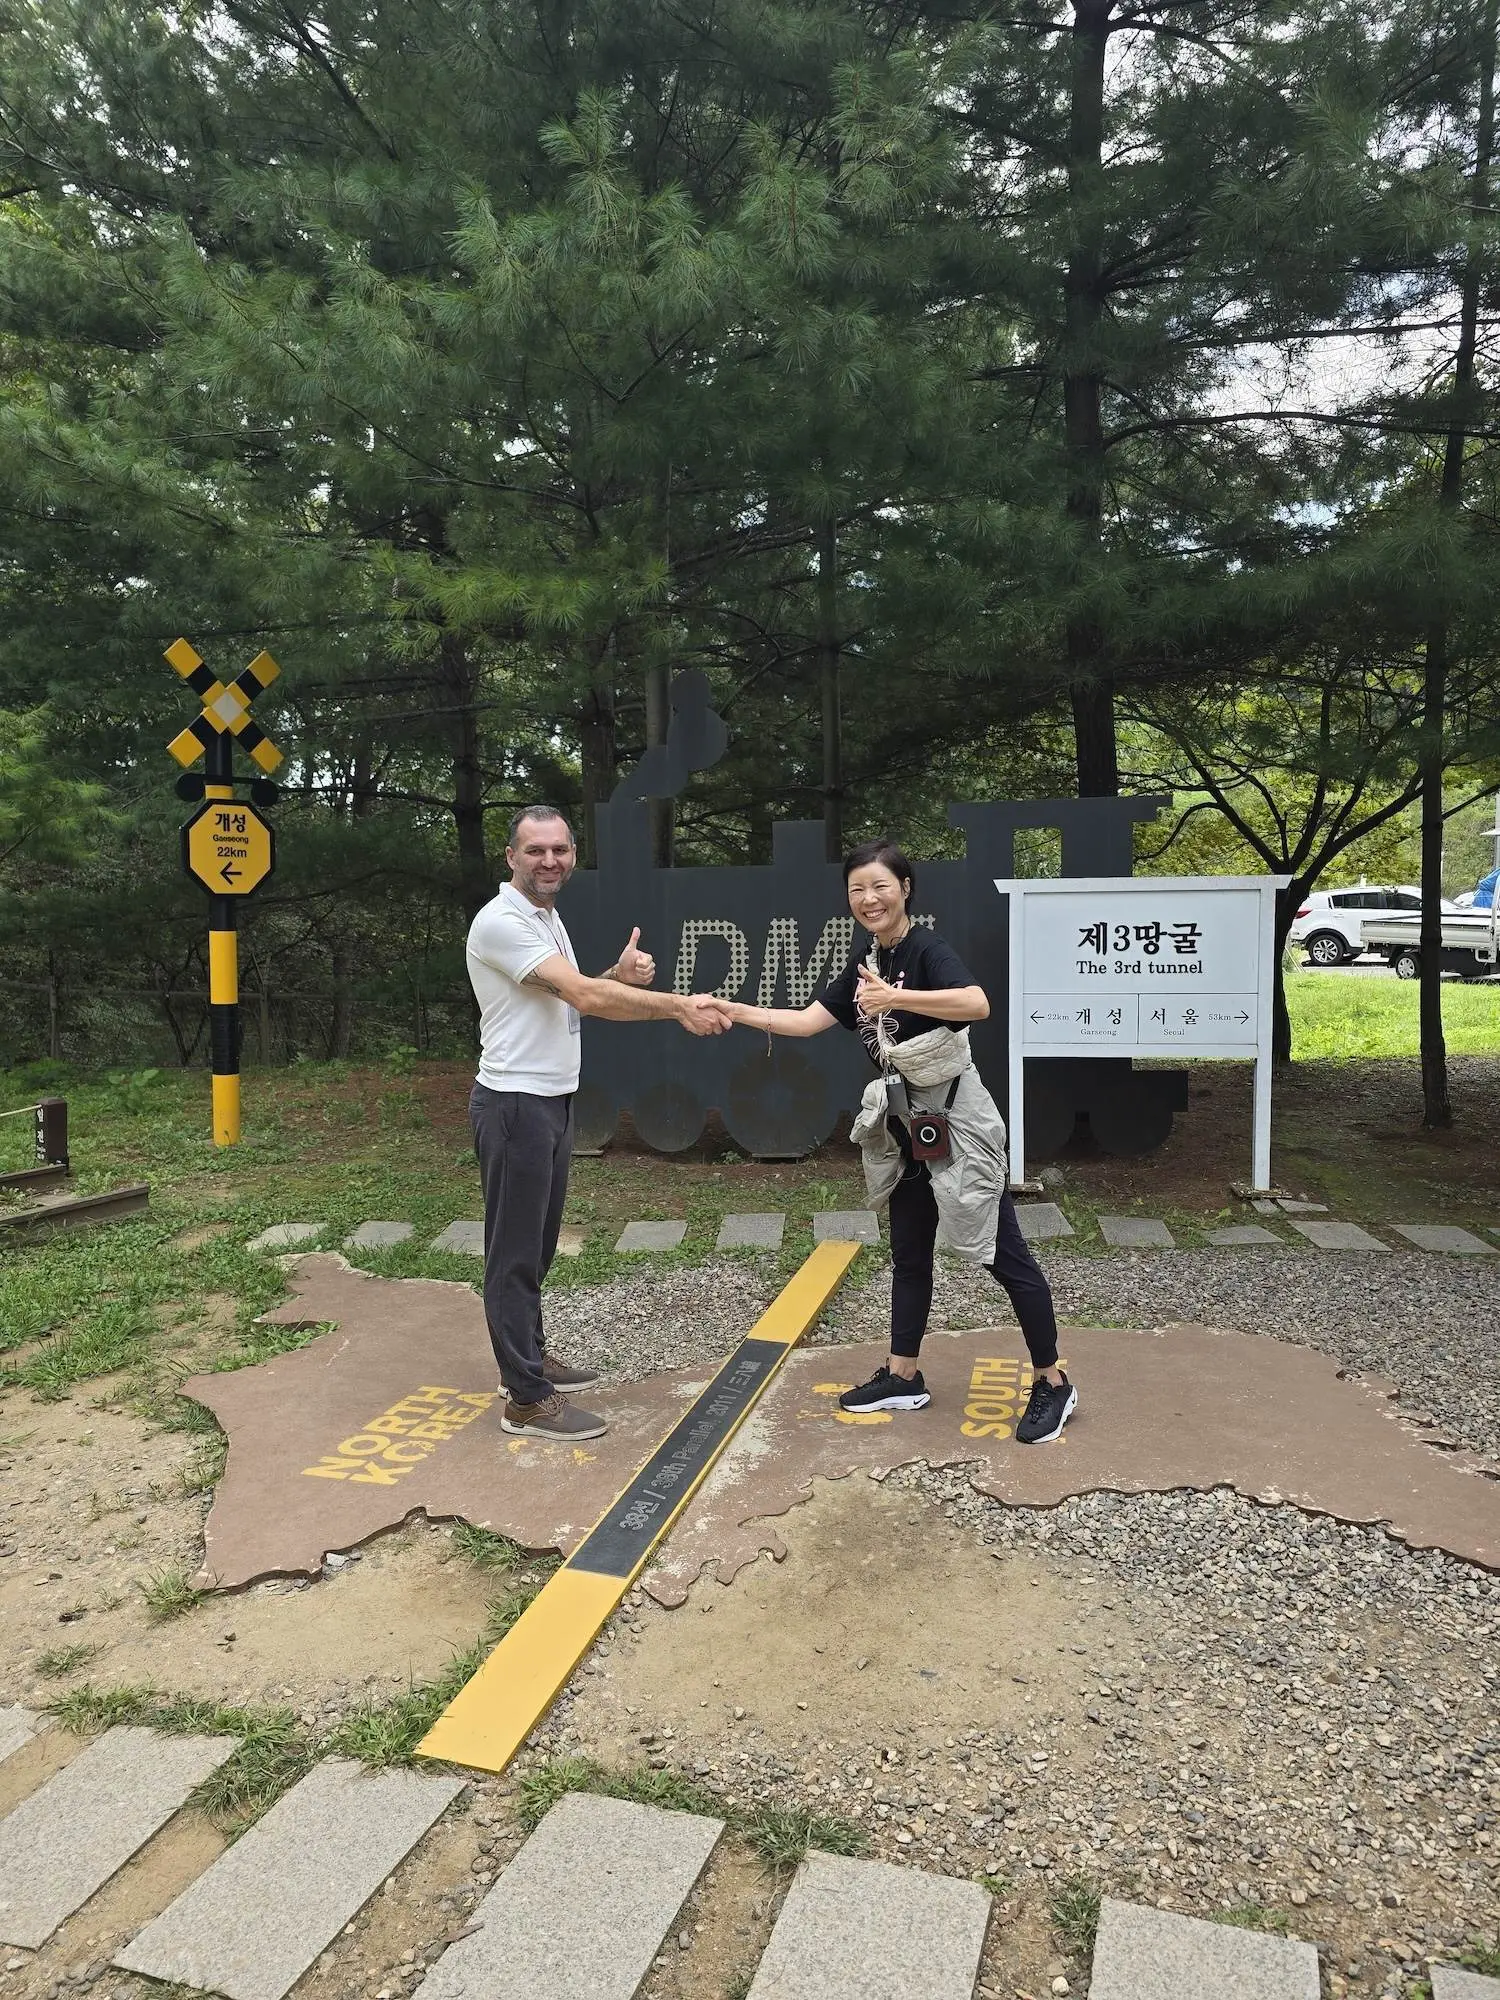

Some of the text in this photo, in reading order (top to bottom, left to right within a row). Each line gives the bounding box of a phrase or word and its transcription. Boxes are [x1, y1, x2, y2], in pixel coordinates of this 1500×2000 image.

[214, 813, 246, 833] 개성
[217, 846, 247, 858] 22km
[672, 914, 936, 1008] DM
[1077, 921, 1202, 956] 제3땅굴
[1076, 960, 1203, 974] The 3rd tunnel
[1047, 1013, 1070, 1021] 22km
[1208, 1013, 1232, 1021] 53km
[960, 1357, 1020, 1440] SOUTH
[301, 1386, 461, 1481] NORTH
[349, 1392, 499, 1486] KOREA
[619, 1500, 660, 1531] 38선
[650, 1462, 687, 1489] 38th
